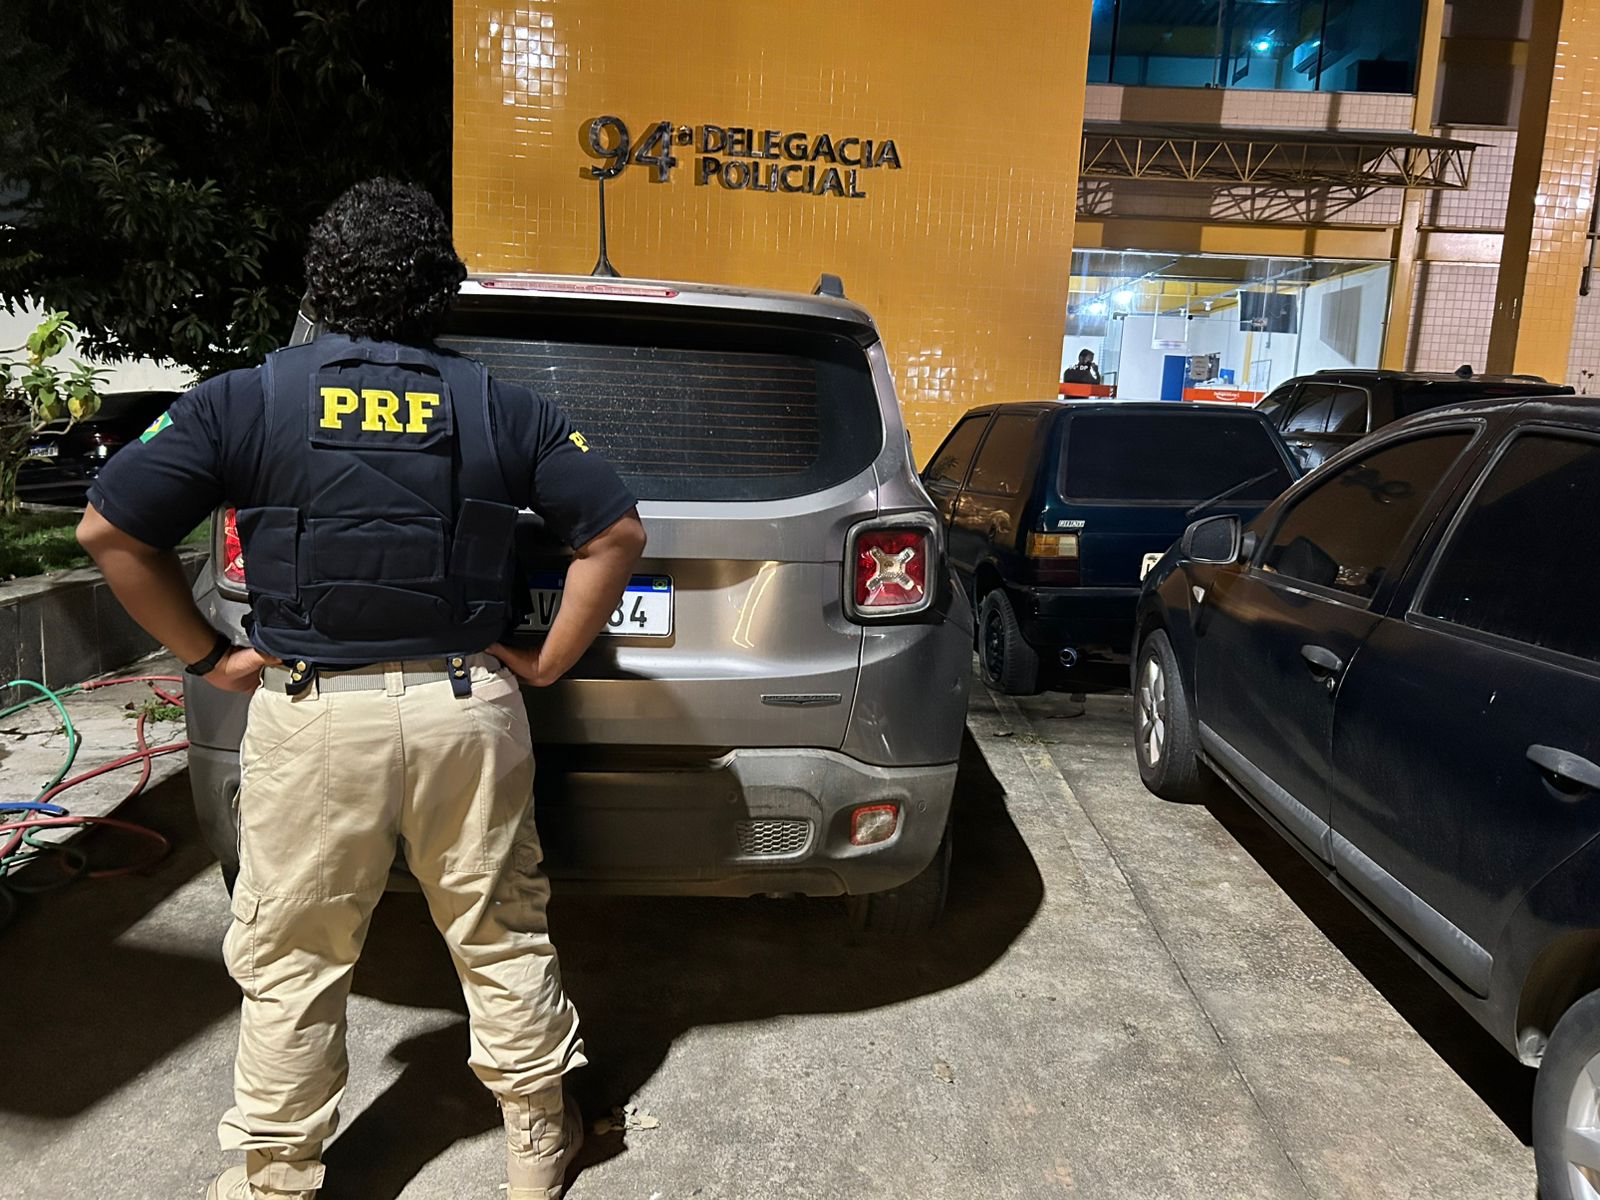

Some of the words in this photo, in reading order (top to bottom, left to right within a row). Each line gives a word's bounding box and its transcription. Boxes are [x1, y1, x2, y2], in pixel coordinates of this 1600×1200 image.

[702, 124, 902, 169] DELEGACIA
[702, 156, 866, 198] POLICIAL
[319, 387, 440, 433] PRF
